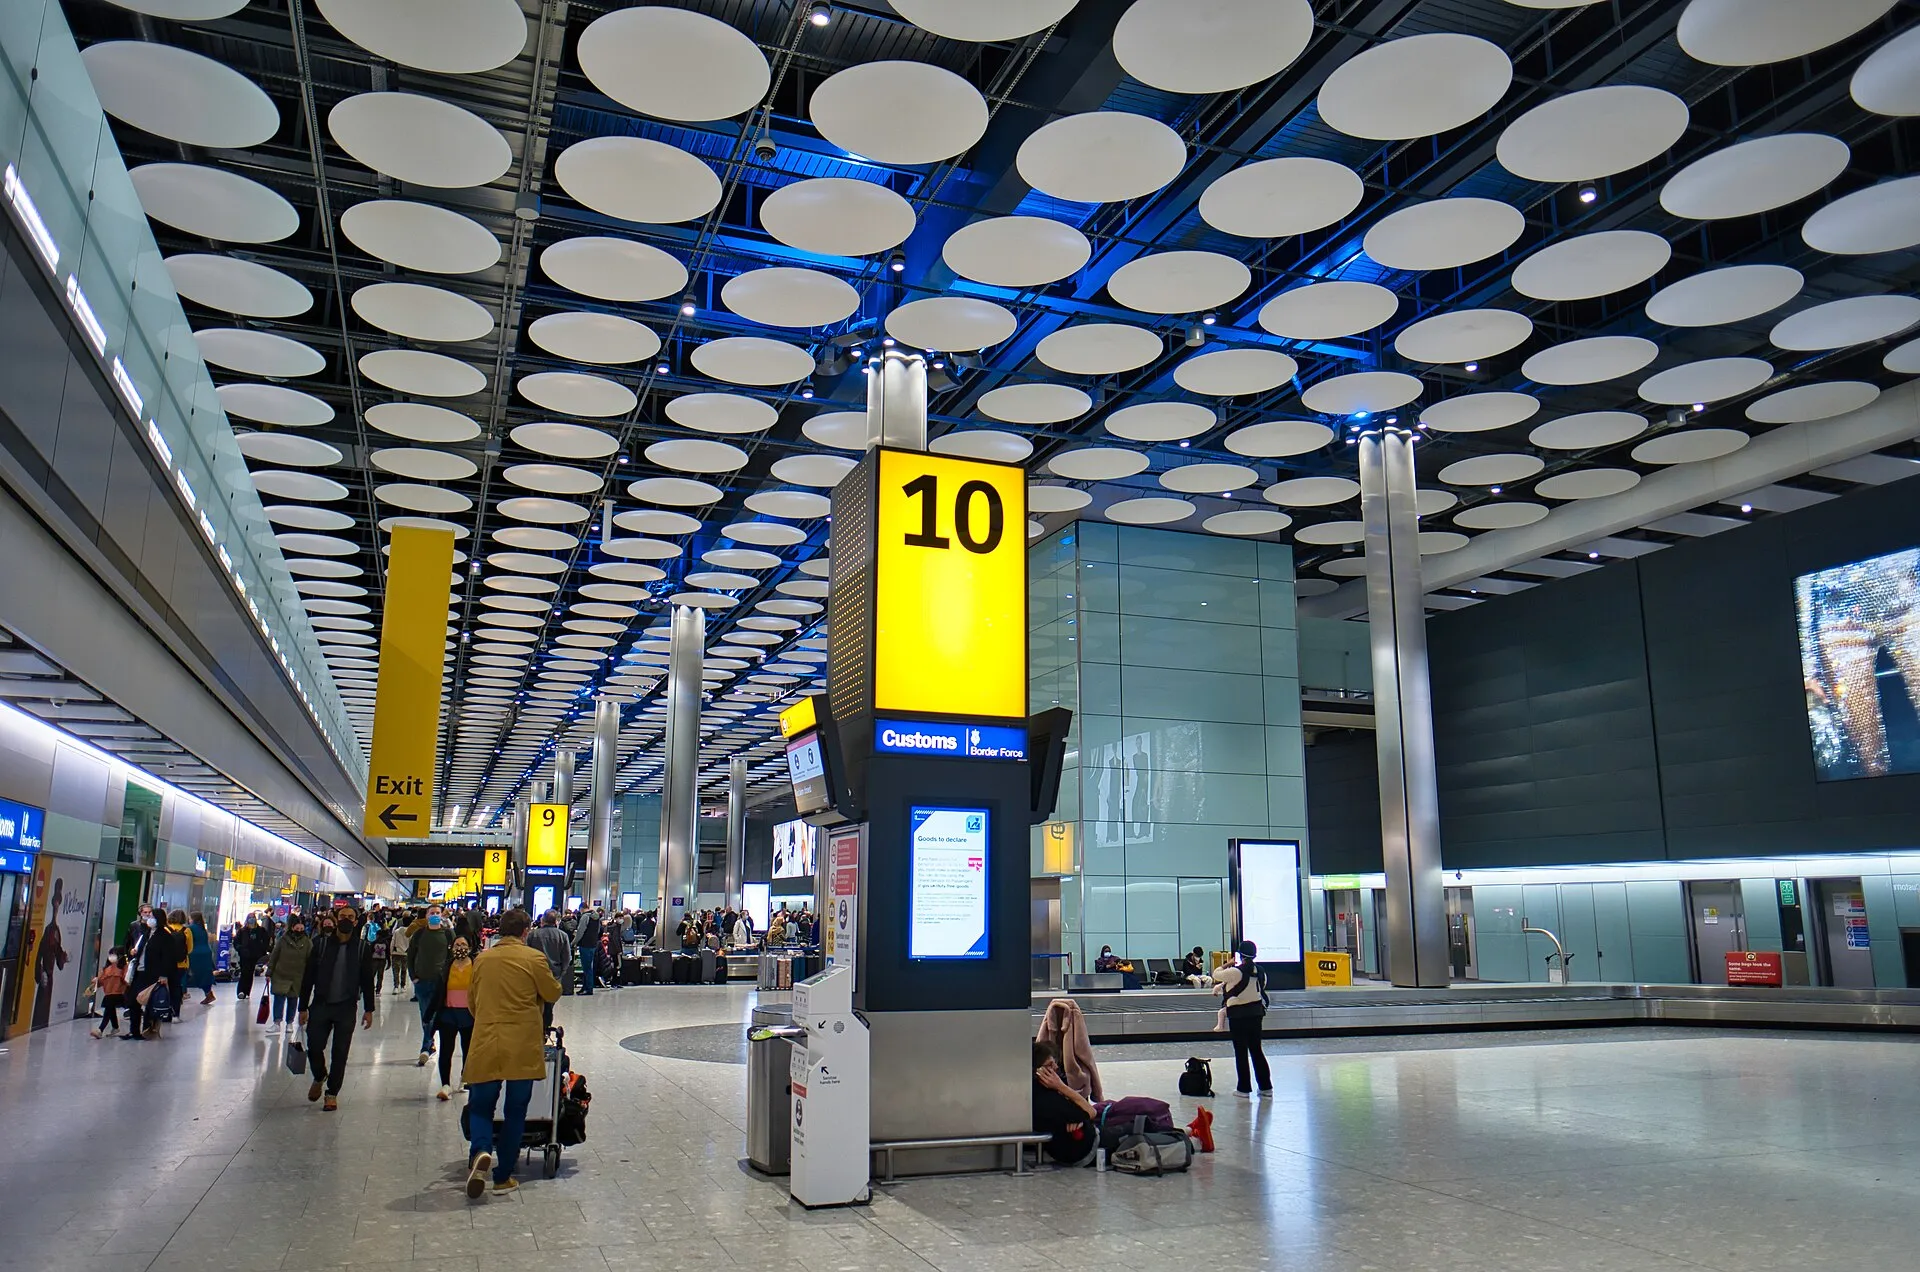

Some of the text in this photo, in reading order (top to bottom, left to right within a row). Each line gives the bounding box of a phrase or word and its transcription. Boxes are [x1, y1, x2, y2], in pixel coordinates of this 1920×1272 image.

[902, 474, 1004, 554] 10
[882, 729, 957, 750] Customs
[970, 746, 1023, 758] Border Force
[376, 776, 423, 796] Exit
[543, 809, 556, 827] 9
[492, 852, 500, 863] 8
[63, 889, 86, 915] Welcome
